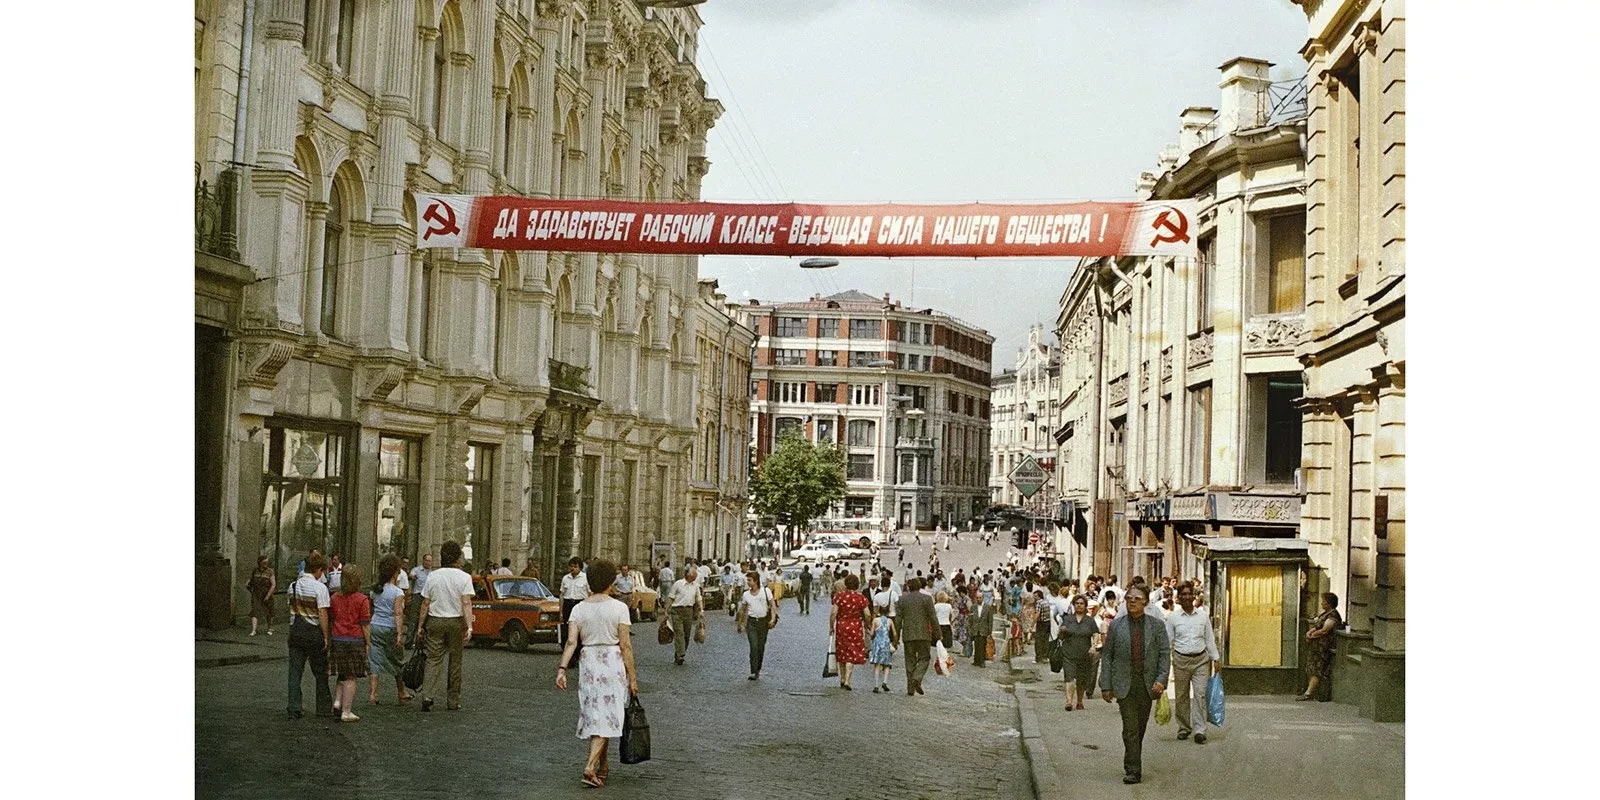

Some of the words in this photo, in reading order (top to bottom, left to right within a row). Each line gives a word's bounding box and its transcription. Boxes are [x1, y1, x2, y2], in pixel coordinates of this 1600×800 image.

[493, 208, 519, 239] ДА
[525, 209, 636, 242] ЗДРАВСТВУЕТ
[639, 212, 716, 243] РАБОЧИЙ
[788, 215, 873, 246] ВЕДУЩАЯ
[877, 215, 925, 245] СИЛА
[932, 214, 1000, 245] НАШЕГО
